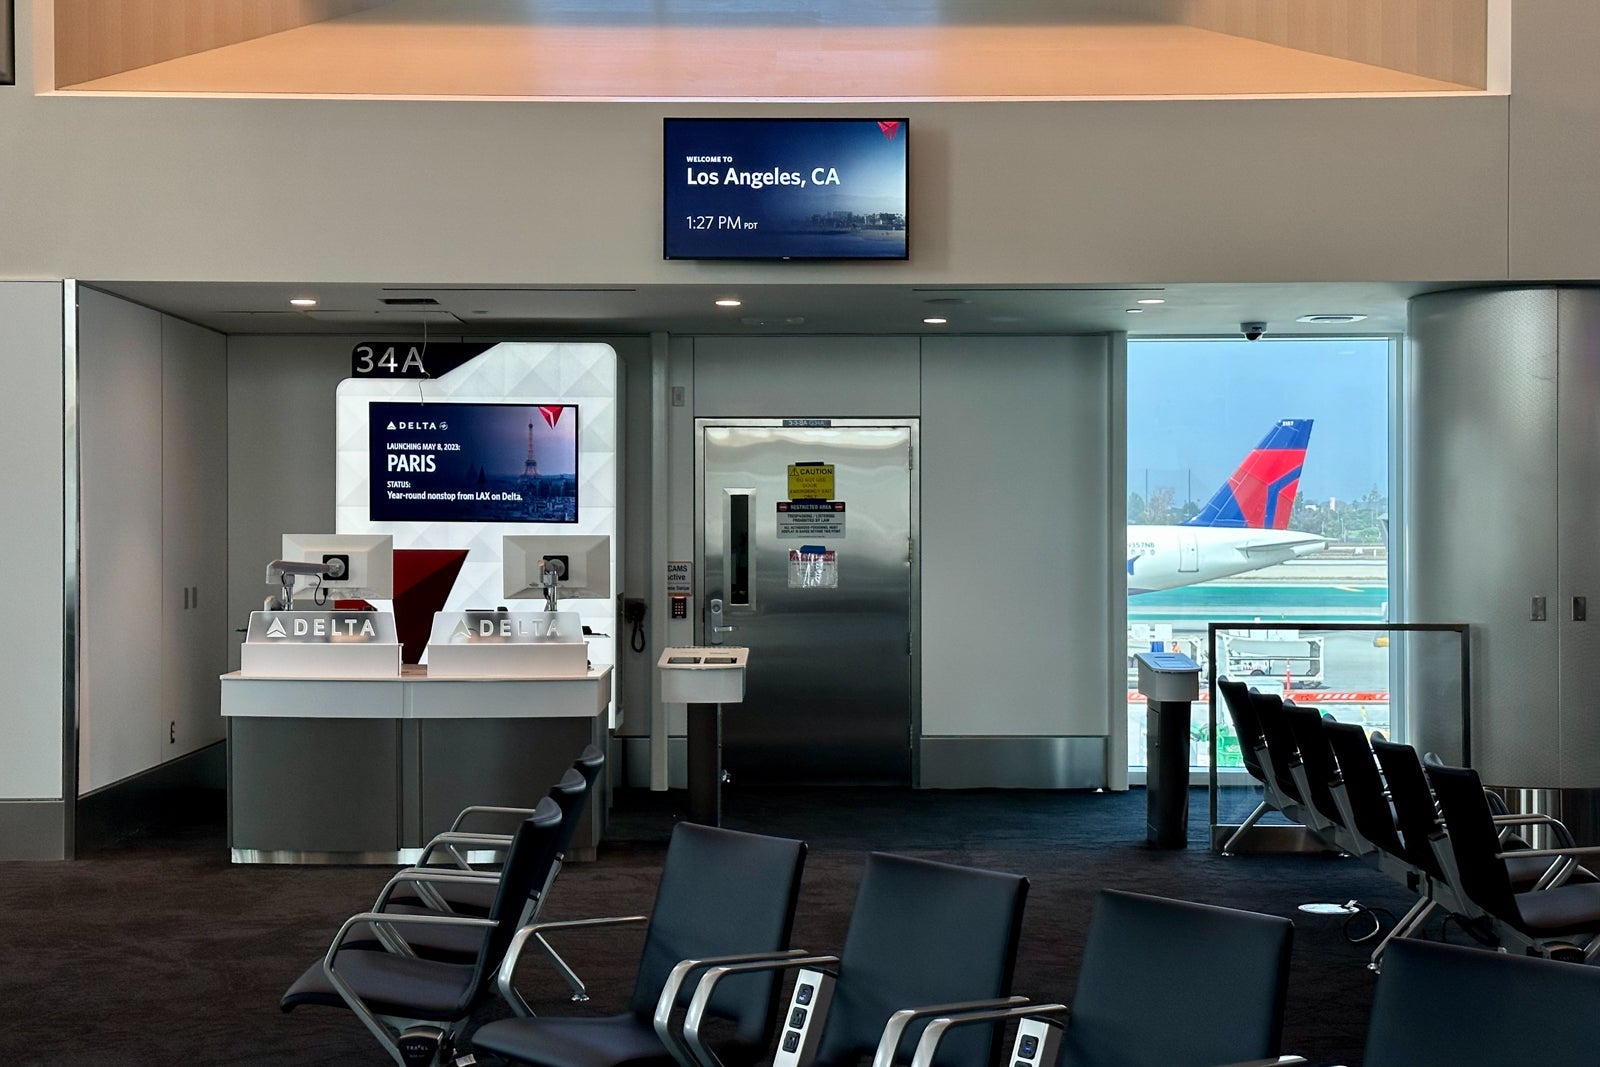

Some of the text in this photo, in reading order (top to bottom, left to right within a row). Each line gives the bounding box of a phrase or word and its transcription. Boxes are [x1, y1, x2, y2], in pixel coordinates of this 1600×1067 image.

[687, 167, 840, 189] Los Angeles, CA
[686, 216, 714, 229] 1:27
[718, 216, 741, 229] PM
[356, 346, 424, 373] 34A
[399, 421, 437, 430] DELTA
[422, 443, 436, 451] MAY
[437, 443, 443, 451] 8,
[444, 443, 461, 451] 2023:
[387, 454, 436, 473] PARIS
[387, 481, 411, 489] STATUS:
[387, 491, 426, 500] Year-round
[427, 493, 455, 502] nonstop
[457, 491, 474, 500] from
[476, 492, 490, 500] LAX
[502, 492, 523, 501] Delta.
[293, 618, 377, 637] DELTA
[480, 618, 561, 637] DELTA
